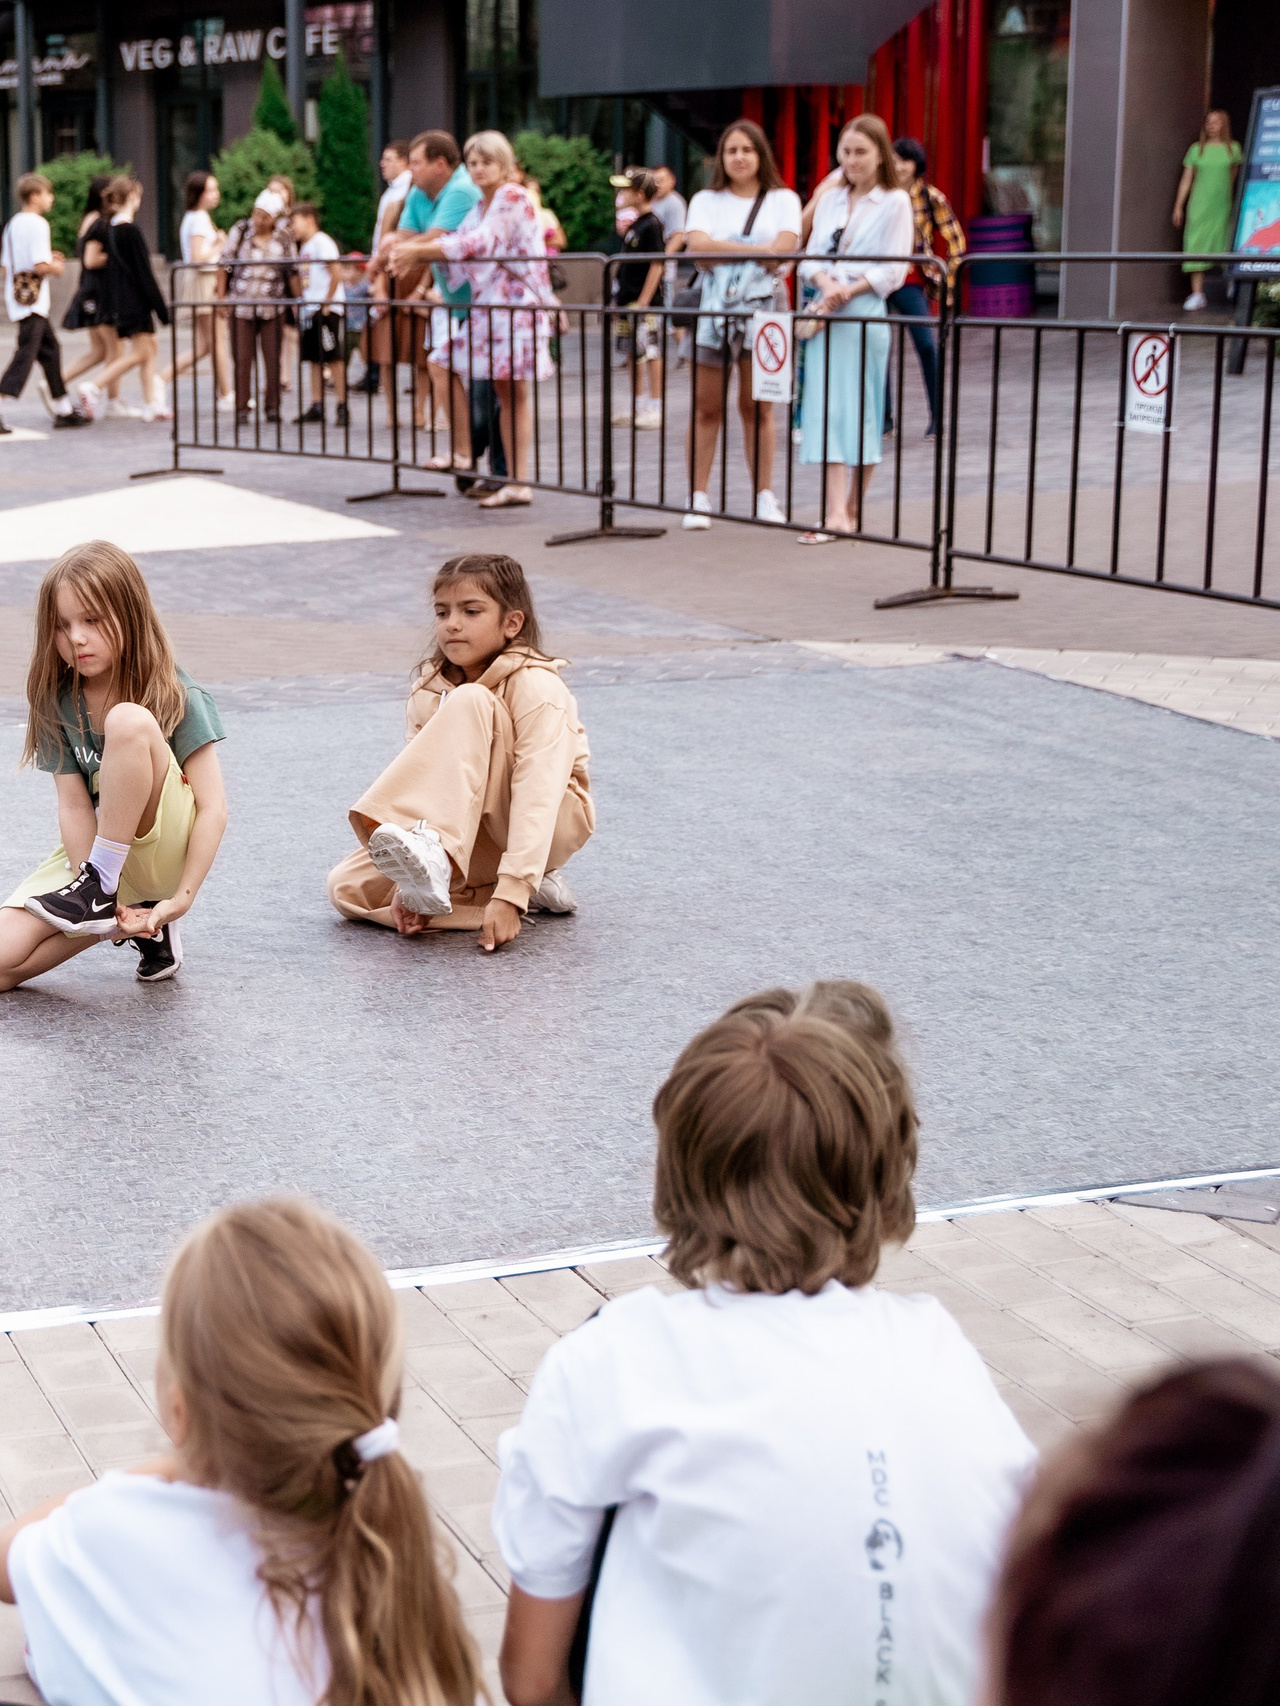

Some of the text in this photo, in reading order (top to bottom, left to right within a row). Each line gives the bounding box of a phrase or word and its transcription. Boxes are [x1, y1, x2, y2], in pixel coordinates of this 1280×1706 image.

[120, 23, 339, 72] VEG & RAW CFE
[1129, 413, 1165, 425] ЗАПРЕЩЕ
[867, 1449, 890, 1508] MDC
[876, 1582, 894, 1686] BLACK
